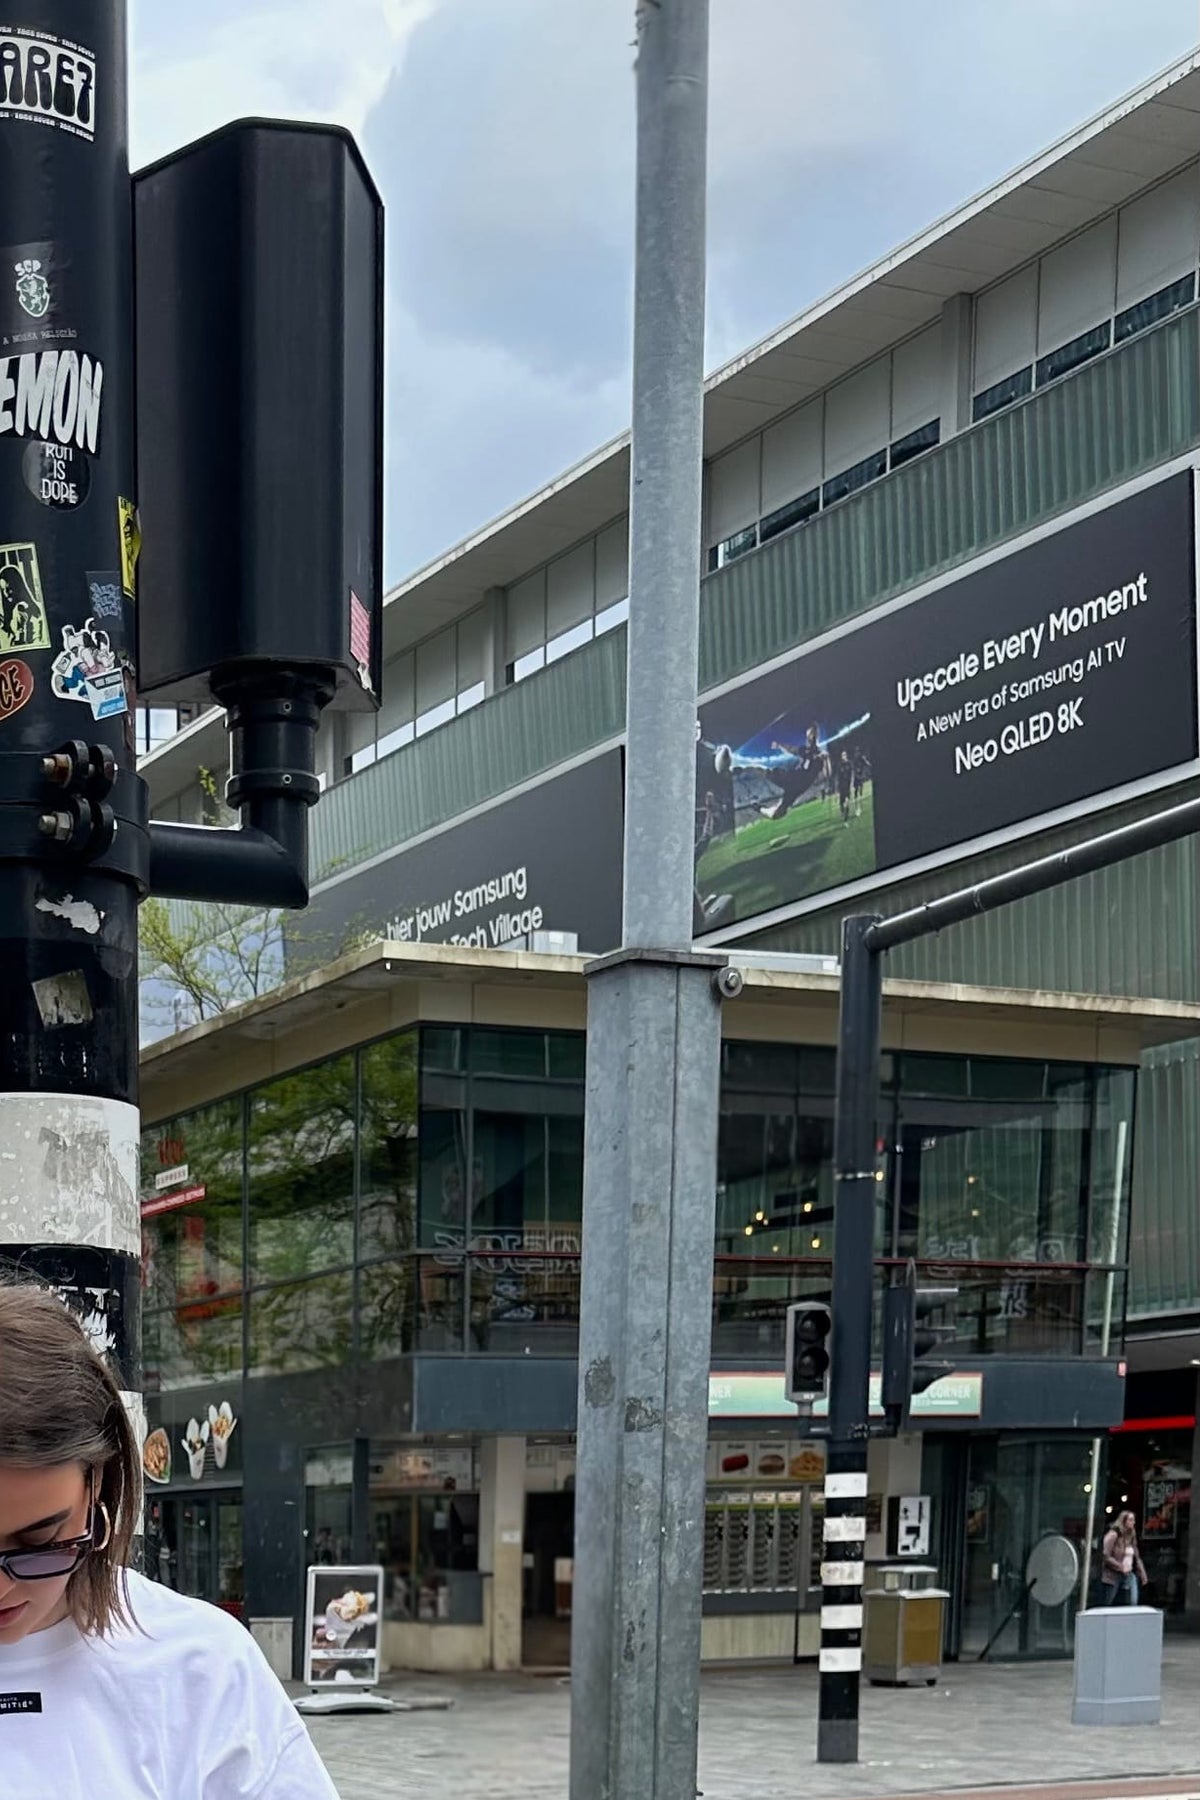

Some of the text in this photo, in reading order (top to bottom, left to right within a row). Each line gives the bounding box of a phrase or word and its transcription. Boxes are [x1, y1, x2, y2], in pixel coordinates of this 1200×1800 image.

[53, 459, 66, 480] IS
[896, 571, 1149, 712] Upscale Every Moment
[916, 636, 1127, 742] A New Era of Samsung AI TV
[954, 696, 1085, 775] Neo QLED 8K
[415, 899, 452, 942] jouw
[453, 866, 527, 918] Samsung
